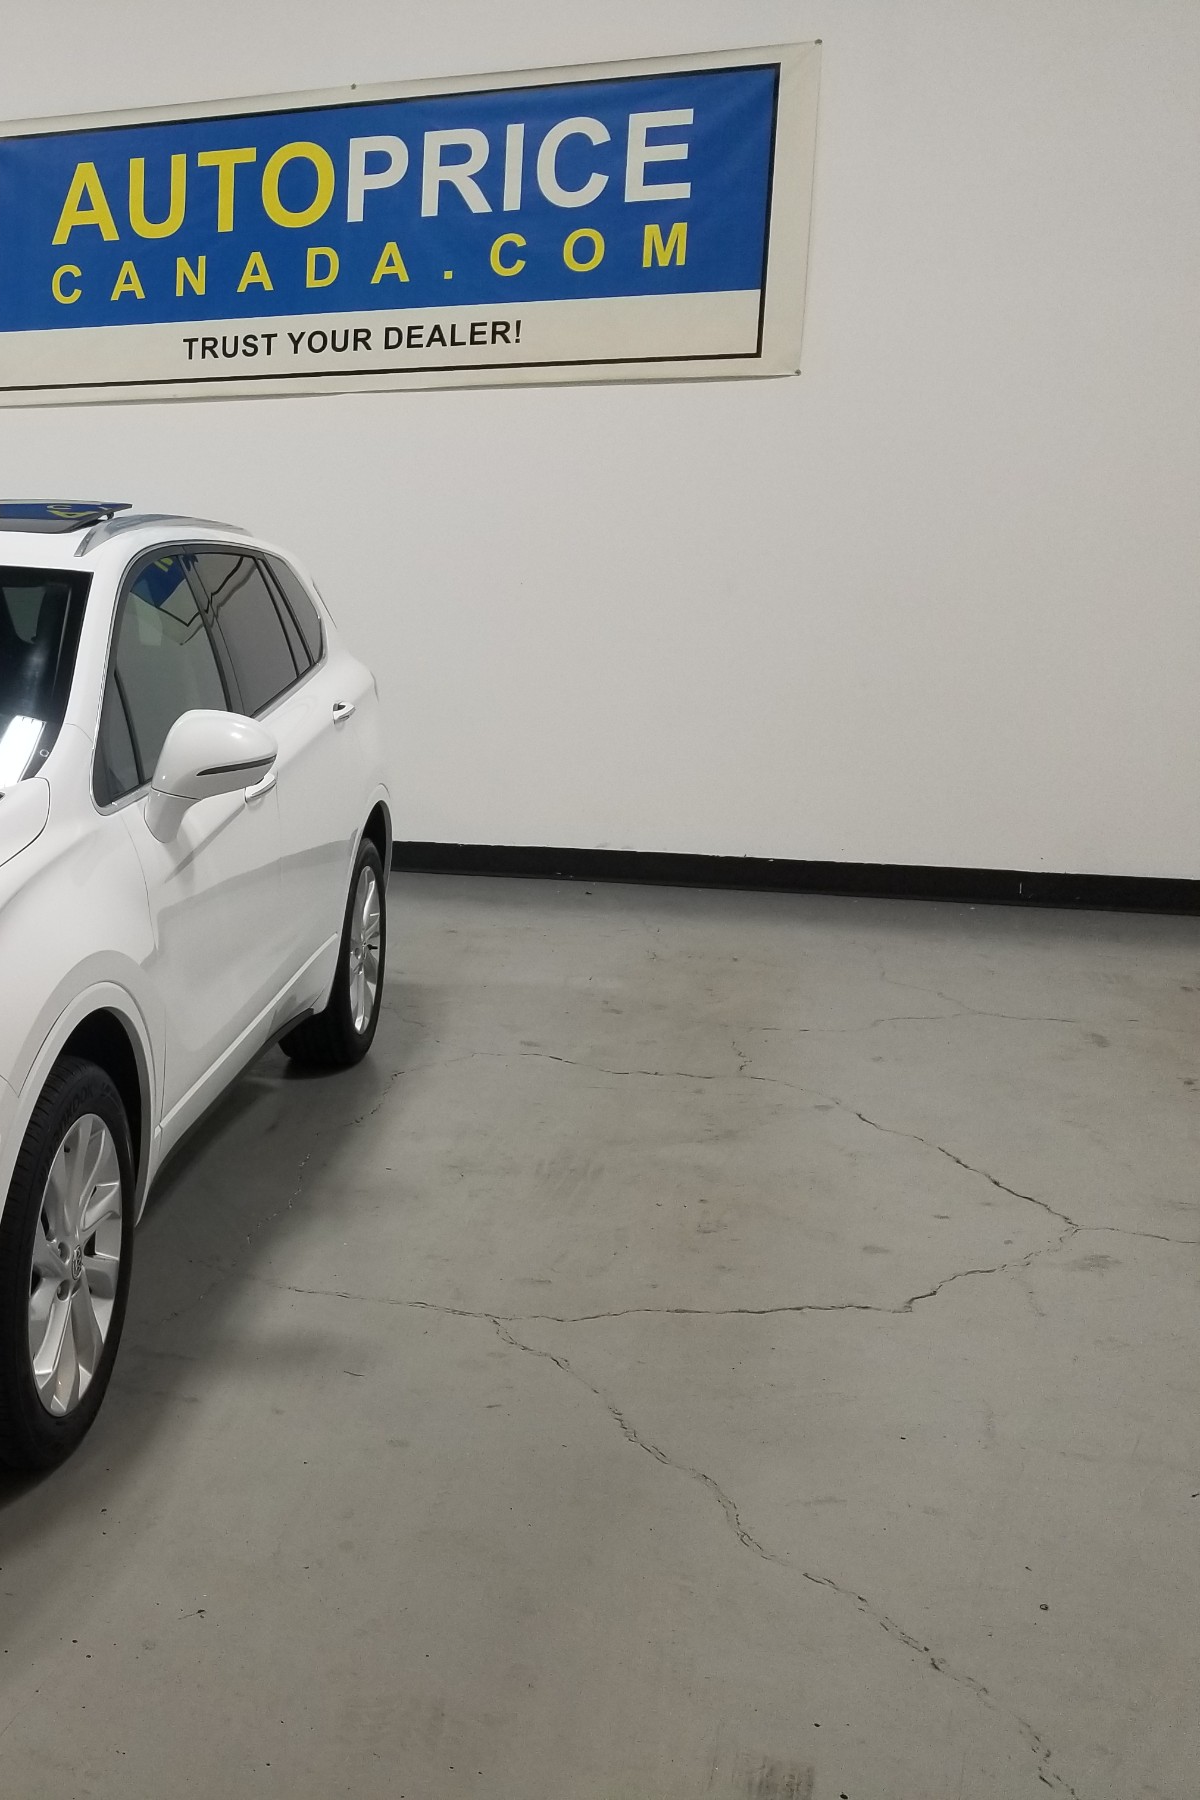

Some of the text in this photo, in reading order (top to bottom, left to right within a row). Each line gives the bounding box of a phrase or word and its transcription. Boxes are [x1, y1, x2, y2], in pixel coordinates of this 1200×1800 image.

[51, 108, 694, 246] AUTOPRICE
[50, 222, 688, 305] CANADA.COM
[182, 319, 522, 360] TRUST YOUR DEALER!
